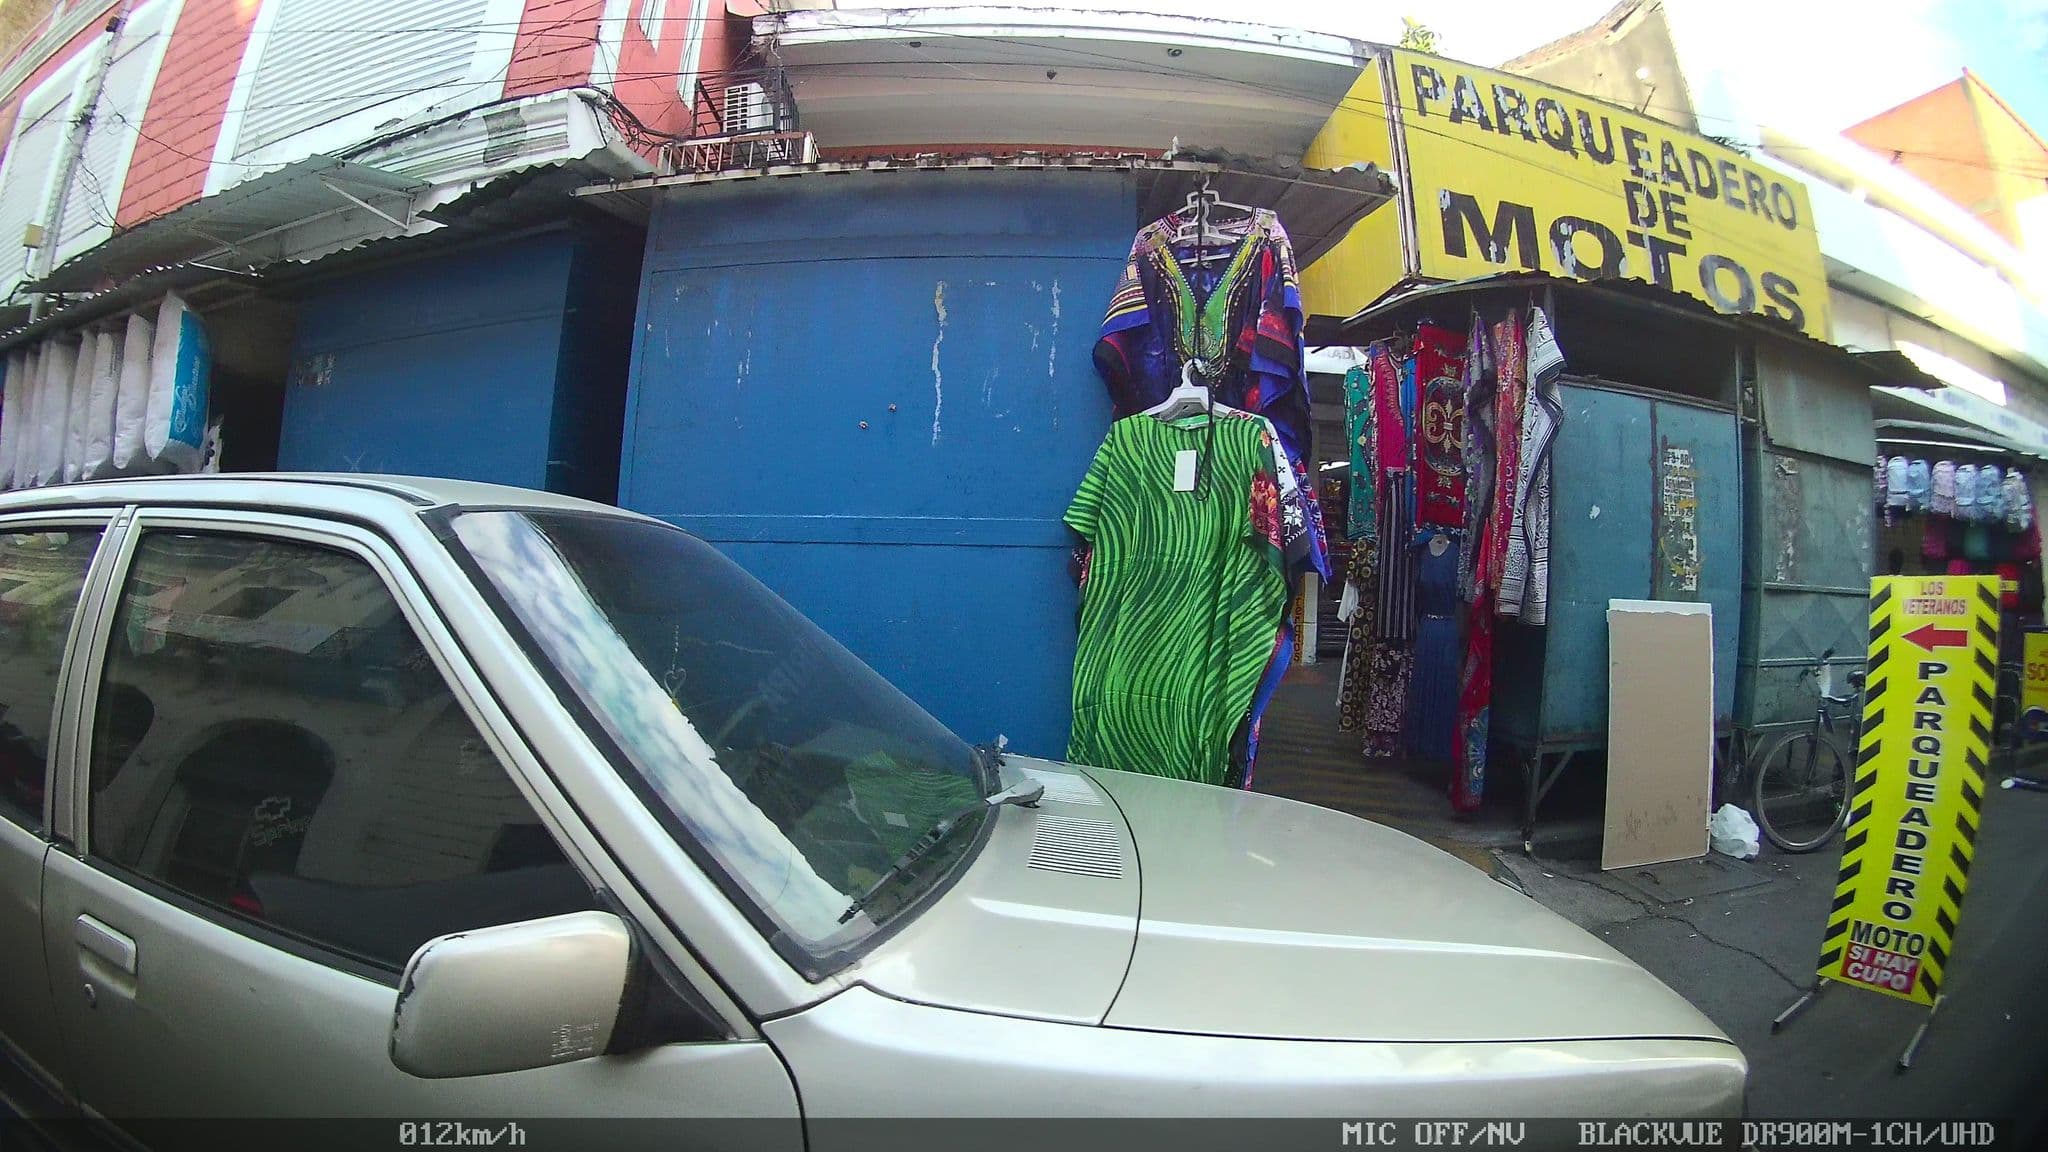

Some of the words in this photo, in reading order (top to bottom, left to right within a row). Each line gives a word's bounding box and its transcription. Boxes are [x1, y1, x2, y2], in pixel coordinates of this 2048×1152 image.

[1411, 64, 1797, 230] PARQUEADERO
[1623, 179, 1692, 240] DE
[1440, 188, 1805, 332] MOTOS
[1902, 598, 1966, 615] VETERANOS
[1920, 581, 1944, 596] LOS
[1882, 662, 1948, 921] PARQUEADERO
[1850, 920, 1925, 956] MOTO
[1847, 962, 1907, 990] CUPO
[1848, 945, 1871, 961] SI
[1873, 951, 1917, 973] HAY
